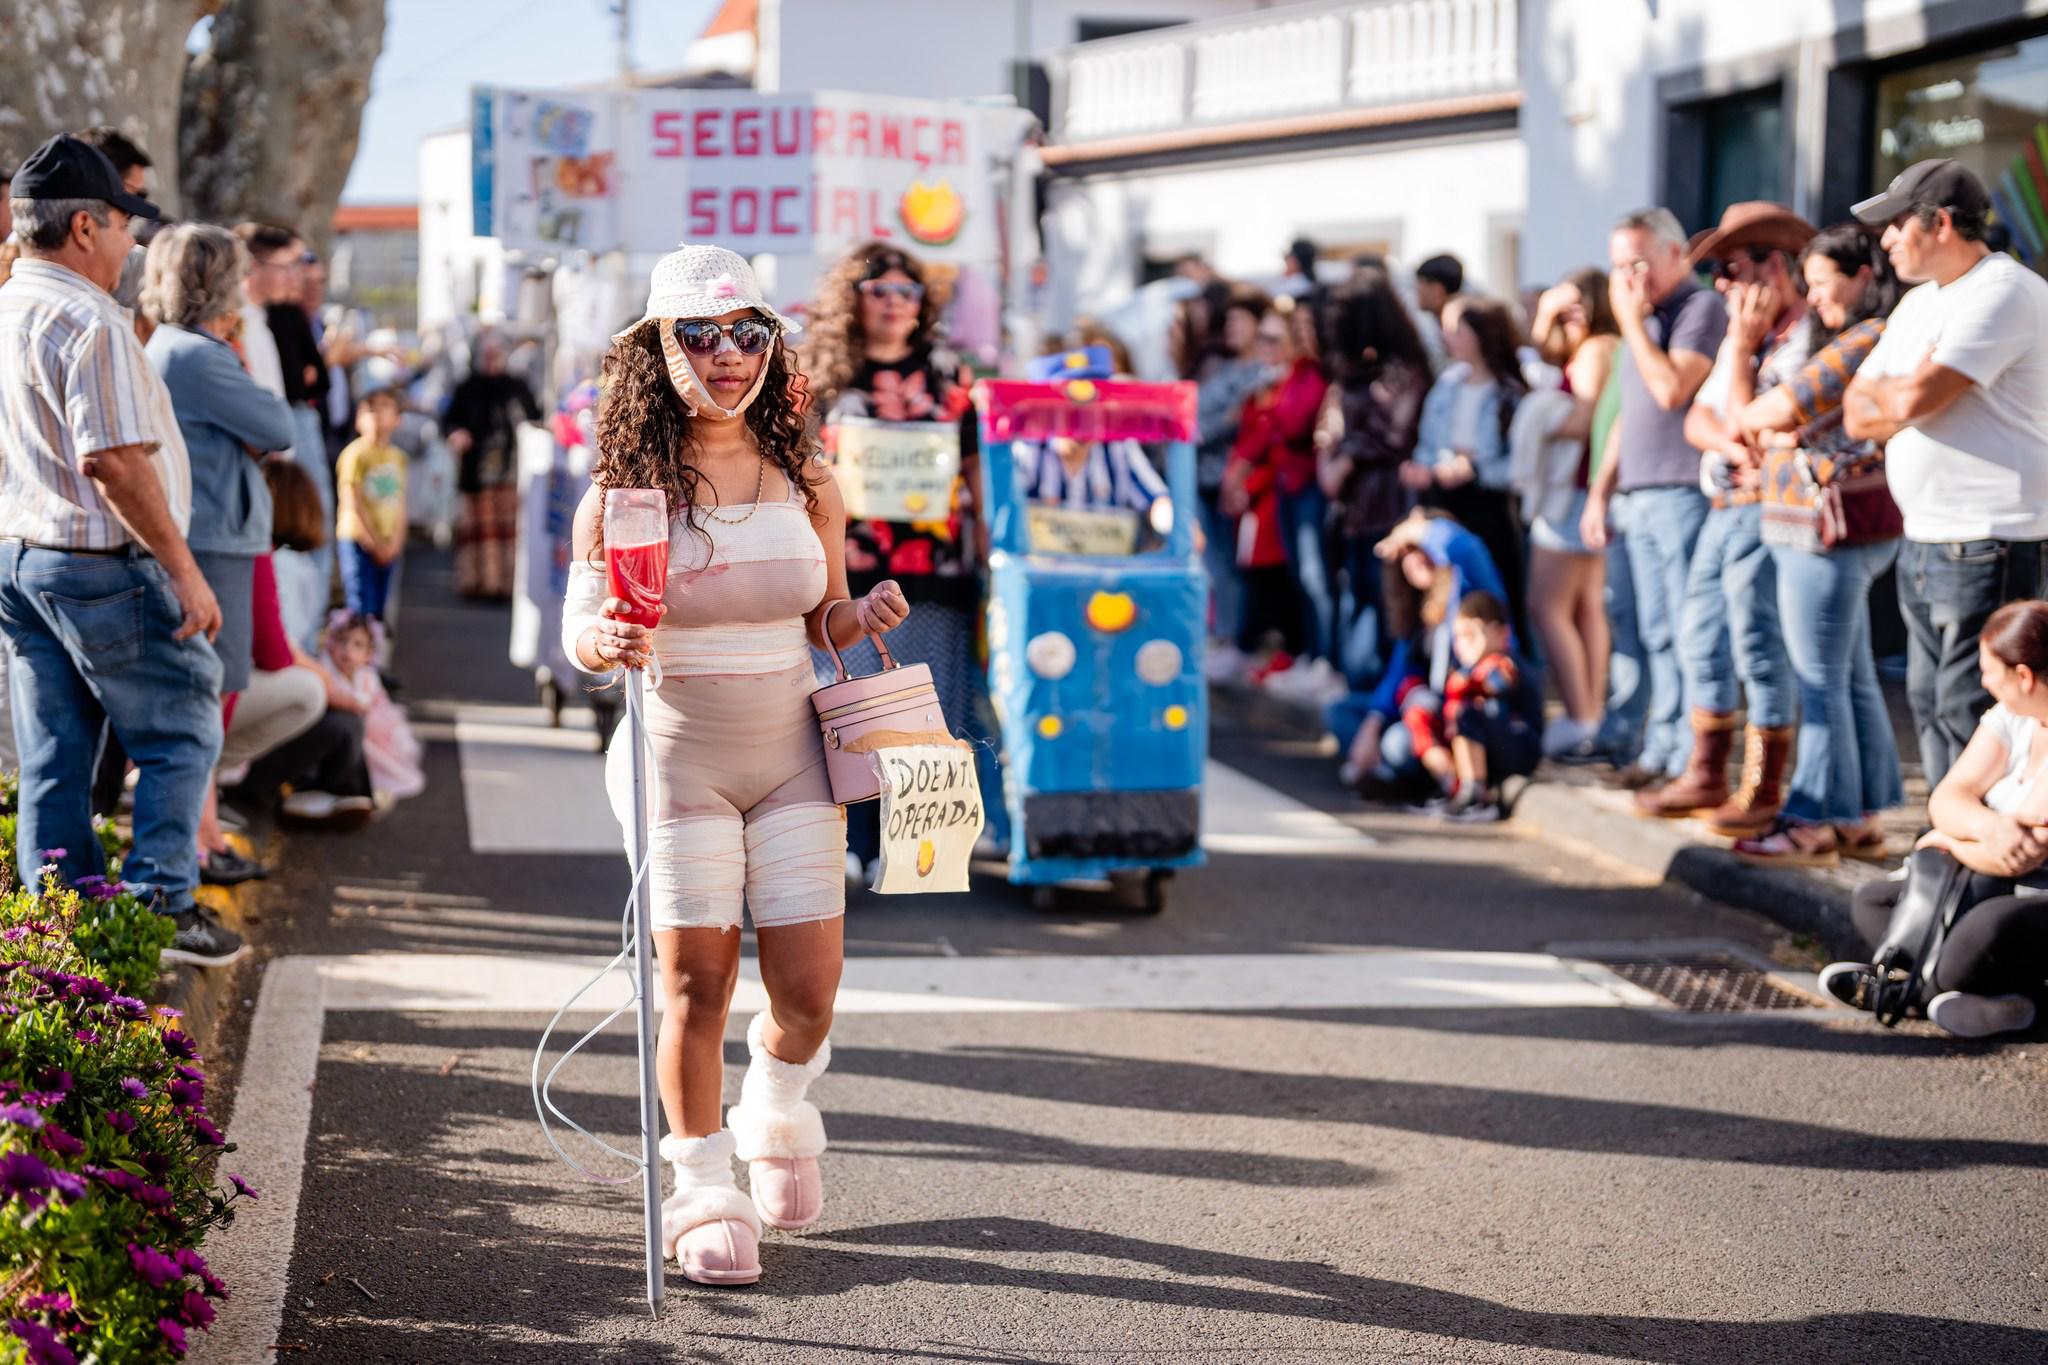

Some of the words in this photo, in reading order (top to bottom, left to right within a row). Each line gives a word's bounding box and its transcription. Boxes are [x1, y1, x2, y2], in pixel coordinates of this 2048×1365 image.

[653, 109, 964, 169] SEGURANÇA
[690, 186, 893, 235] SOCIAL
[888, 801, 979, 841] OPERADA
